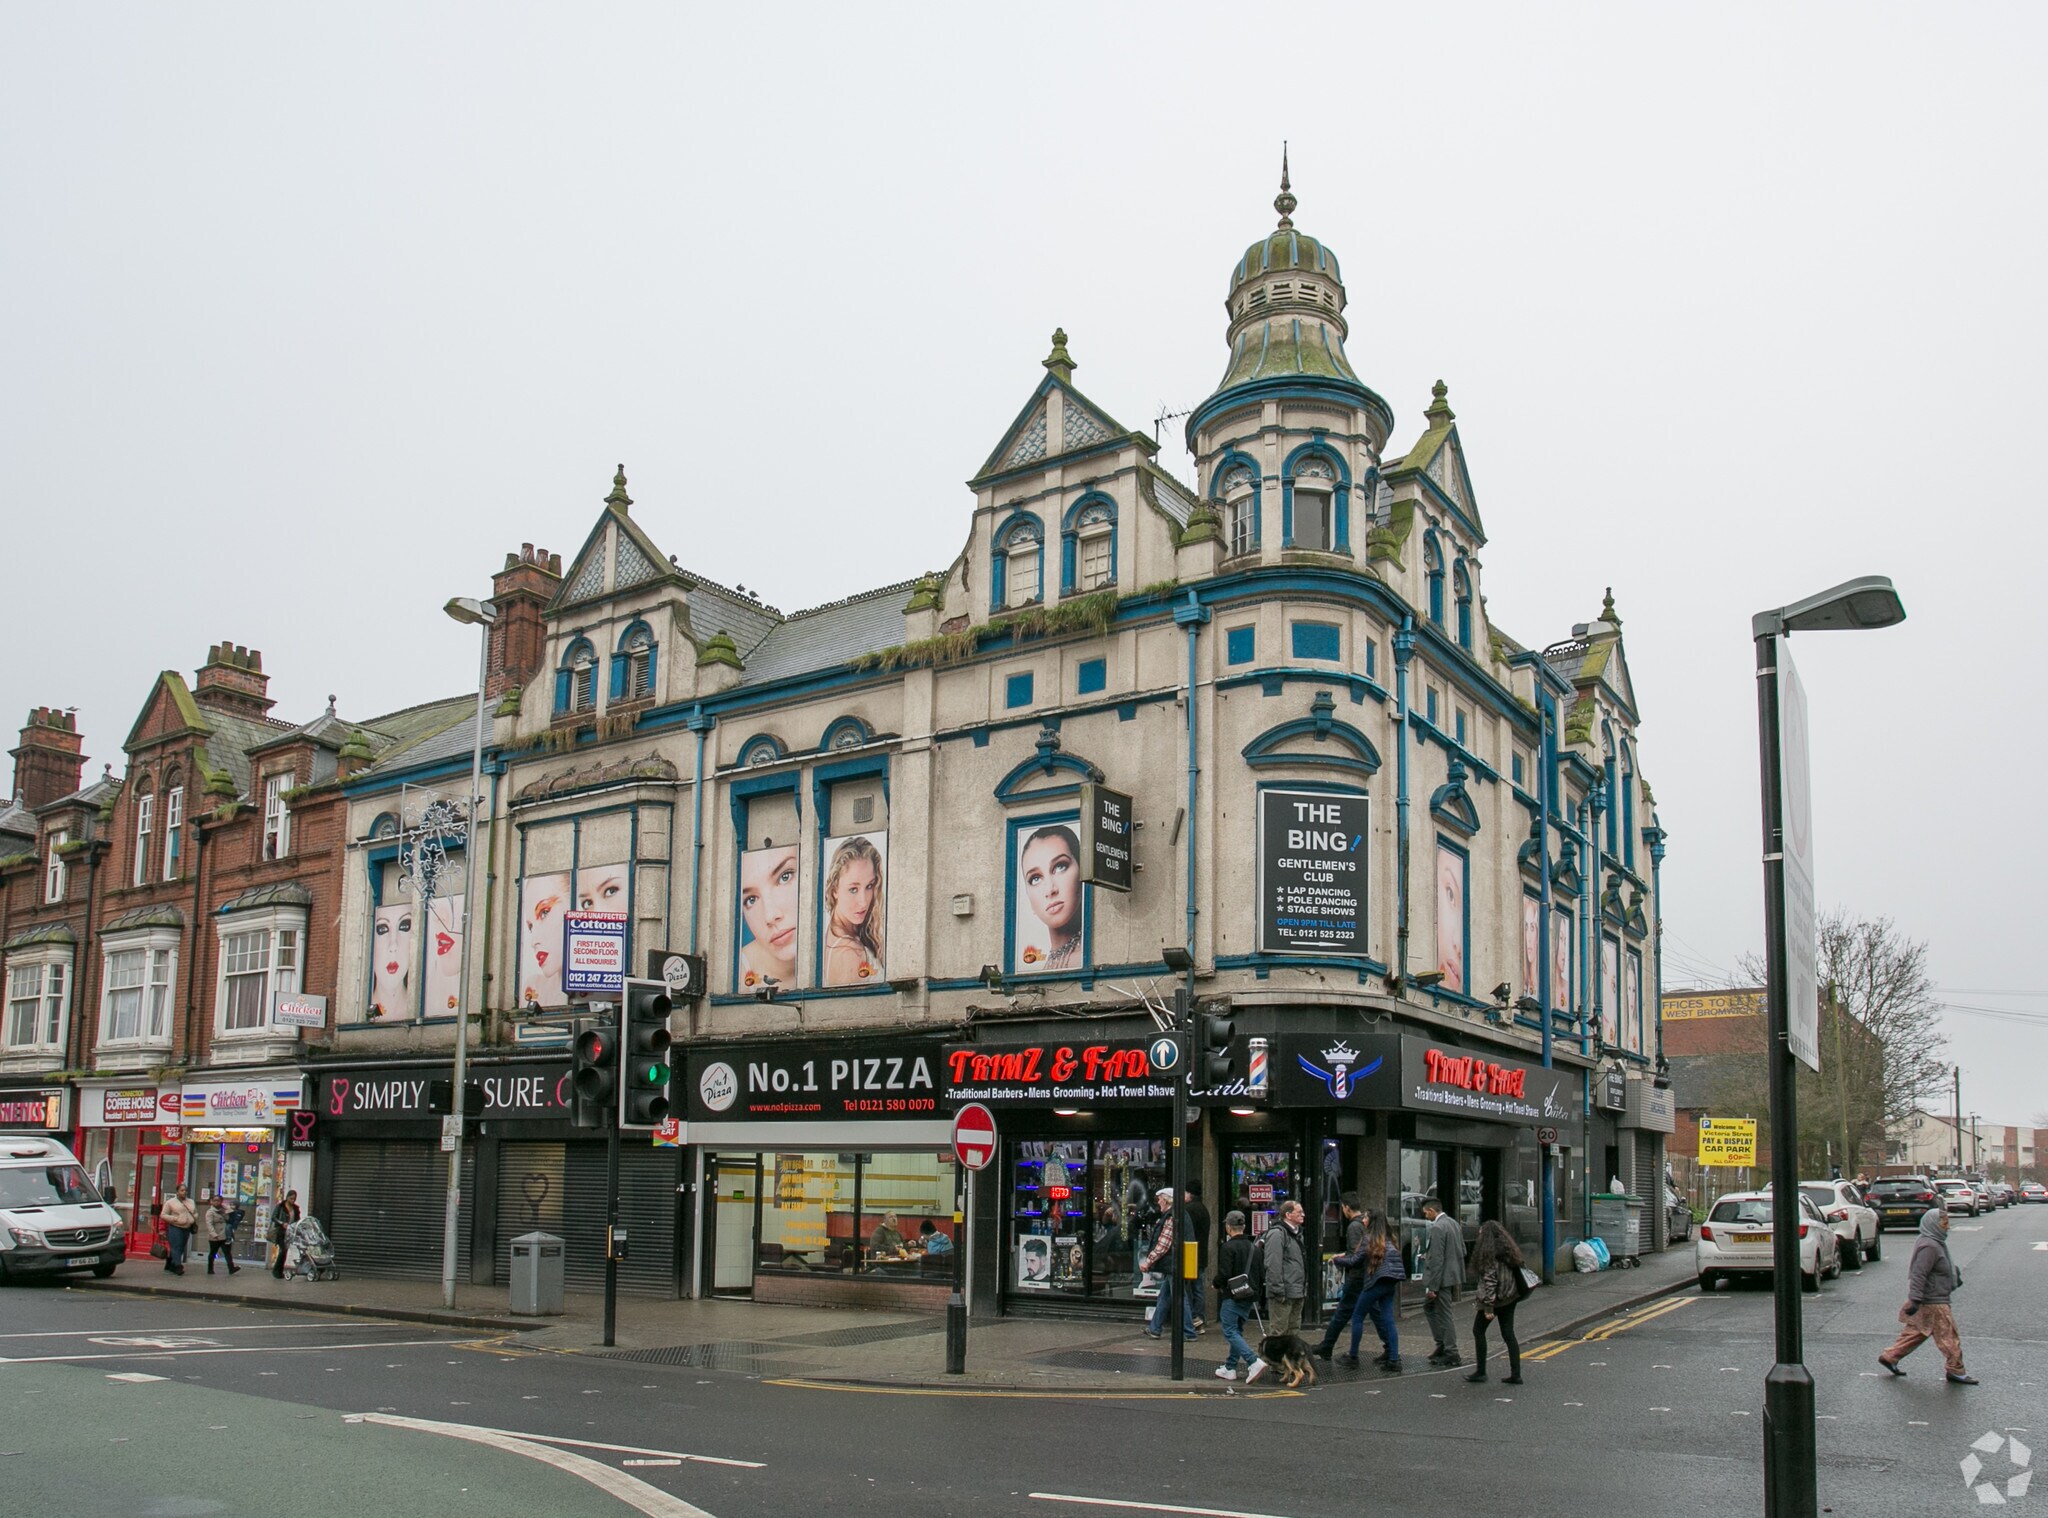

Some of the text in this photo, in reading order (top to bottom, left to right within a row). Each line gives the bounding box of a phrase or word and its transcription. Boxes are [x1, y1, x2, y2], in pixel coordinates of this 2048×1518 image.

[1103, 800, 1120, 817] THE
[1293, 802, 1342, 824] THE
[1095, 842, 1129, 860] GENTLEMEN'S
[1105, 858, 1119, 870] CLUB
[1277, 858, 1356, 872] GENTLEMEN'S
[1303, 871, 1334, 883] CLUB
[1287, 886, 1351, 897] LAP DANCING
[1287, 896, 1358, 907] POLE DANCING
[567, 911, 627, 920] SHOPS UNAFFECTED
[1287, 905, 1356, 916] STAGE SHOWS
[570, 919, 623, 930] Cottons
[1276, 918, 1356, 929] OPEN 9PM TILL LATE
[1278, 928, 1355, 940] TEL: 0121 525 2323
[576, 940, 594, 948] FIRST
[573, 948, 619, 957] SECOND FLOOR
[586, 958, 617, 966] ENQUIRIES
[568, 973, 623, 983] 0121 247 2233
[666, 972, 688, 983] Pizza
[279, 1001, 322, 1015] Chicken
[1662, 999, 1704, 1010] FFICES
[1709, 998, 1726, 1008] TO
[1665, 1009, 1693, 1018] WEST
[948, 1045, 1150, 1084] TRIMZ & FAD
[1424, 1048, 1473, 1090] TRIMZ
[1472, 1059, 1487, 1092] &
[749, 1056, 934, 1092] No.1 PIZZA
[353, 1080, 425, 1110] SIMPLY
[703, 1086, 733, 1104] Pizza
[948, 1084, 1176, 1100] Traditional Barbers Mens Grooming Hot Towel Shave
[105, 1096, 155, 1111] COFFEE HOUSE
[210, 1090, 247, 1108] Chicken
[1416, 1086, 1540, 1118] Traditional Barbers Mens Grooming Hot Towel Shaves
[749, 1098, 935, 1113] www.no1pizza.com Tel 0121 580 0070
[1703, 1120, 1710, 1128] P
[660, 1128, 676, 1136] EAT
[1541, 1130, 1555, 1140] 20
[292, 1140, 315, 1148] SIMPLY
[1173, 1138, 1179, 1146] 3
[1723, 1137, 1753, 1145] DISPLAY
